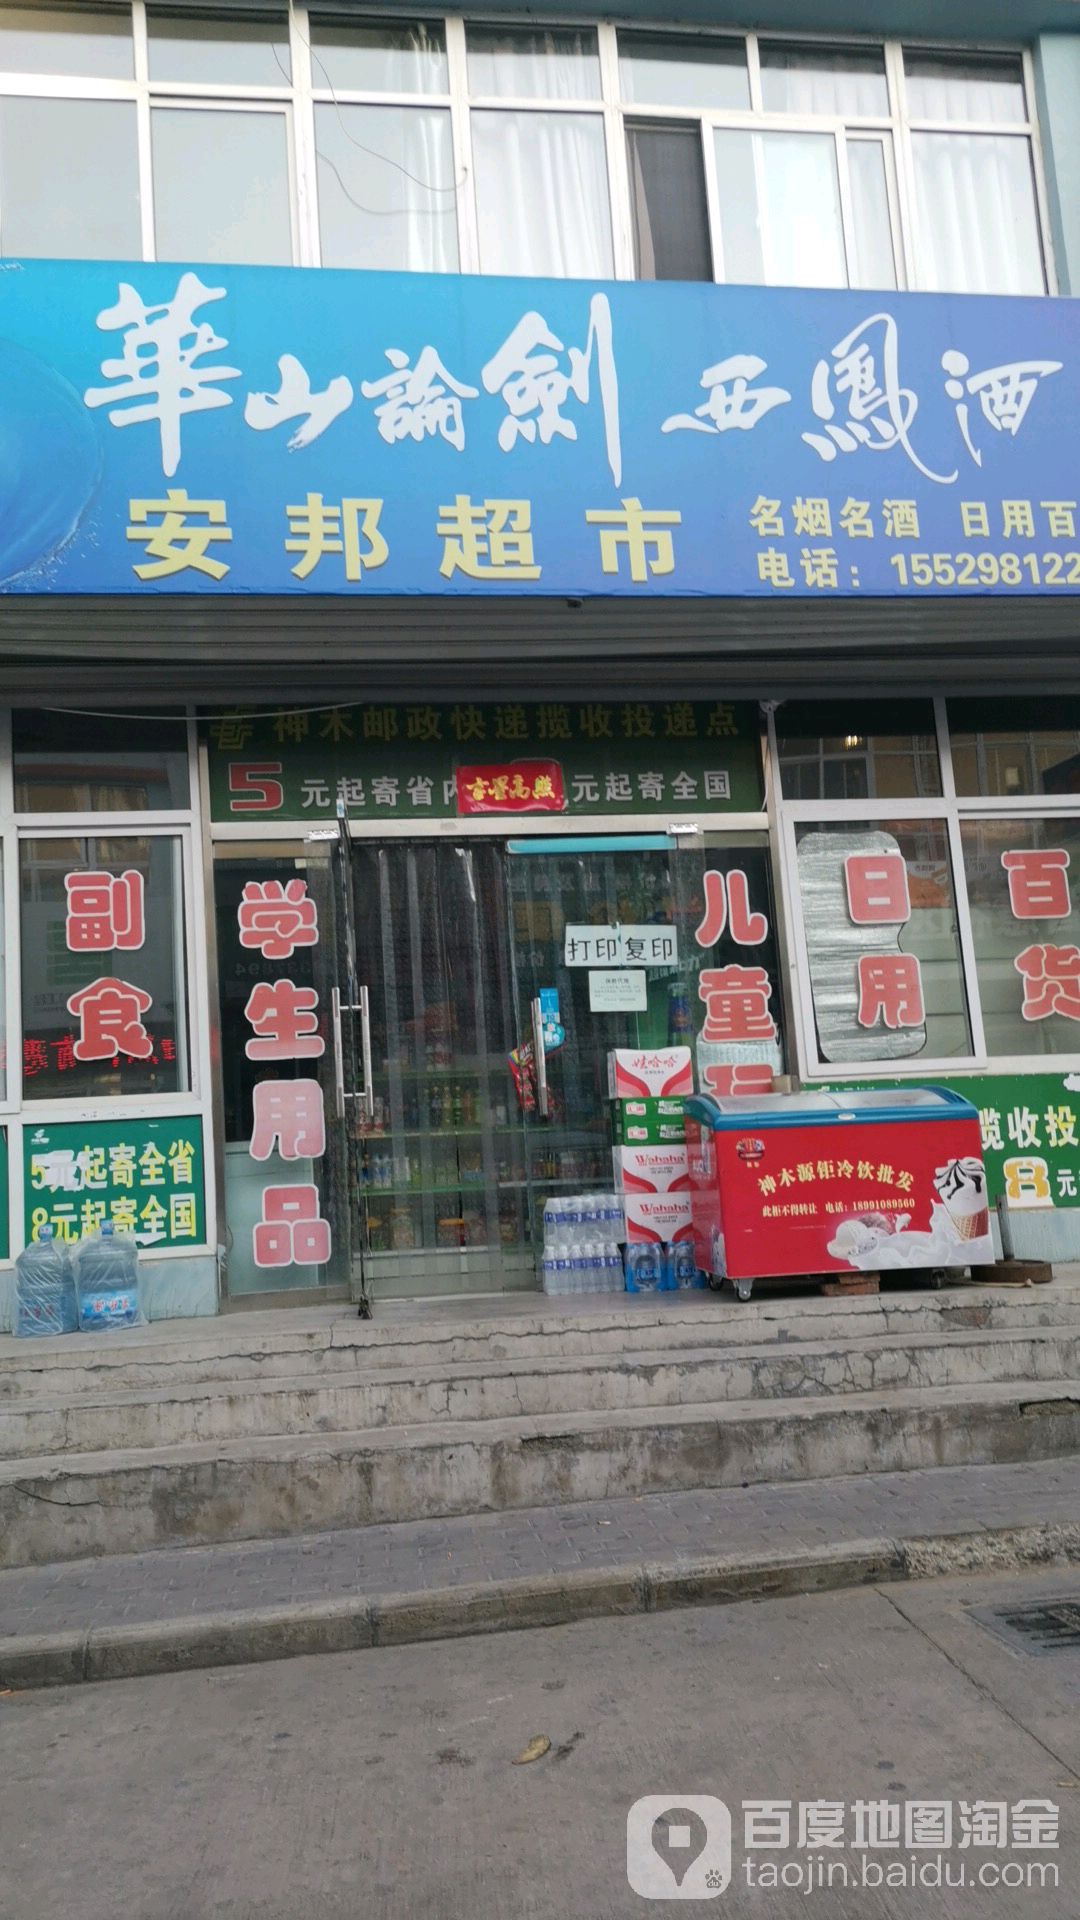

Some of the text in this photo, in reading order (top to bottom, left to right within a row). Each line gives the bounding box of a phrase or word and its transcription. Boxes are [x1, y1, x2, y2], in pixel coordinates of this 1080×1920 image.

[126, 489, 682, 583] 安邦超市
[749, 496, 1077, 539] 名烟名酒 日用百
[272, 702, 741, 744] 神木邮政快递揽收投递点
[64, 870, 153, 1060] 副食
[567, 937, 673, 961] 打印复印
[845, 854, 926, 1029] 日用
[238, 879, 332, 1267] 学生用品
[632, 1055, 677, 1070] 娃哈哈
